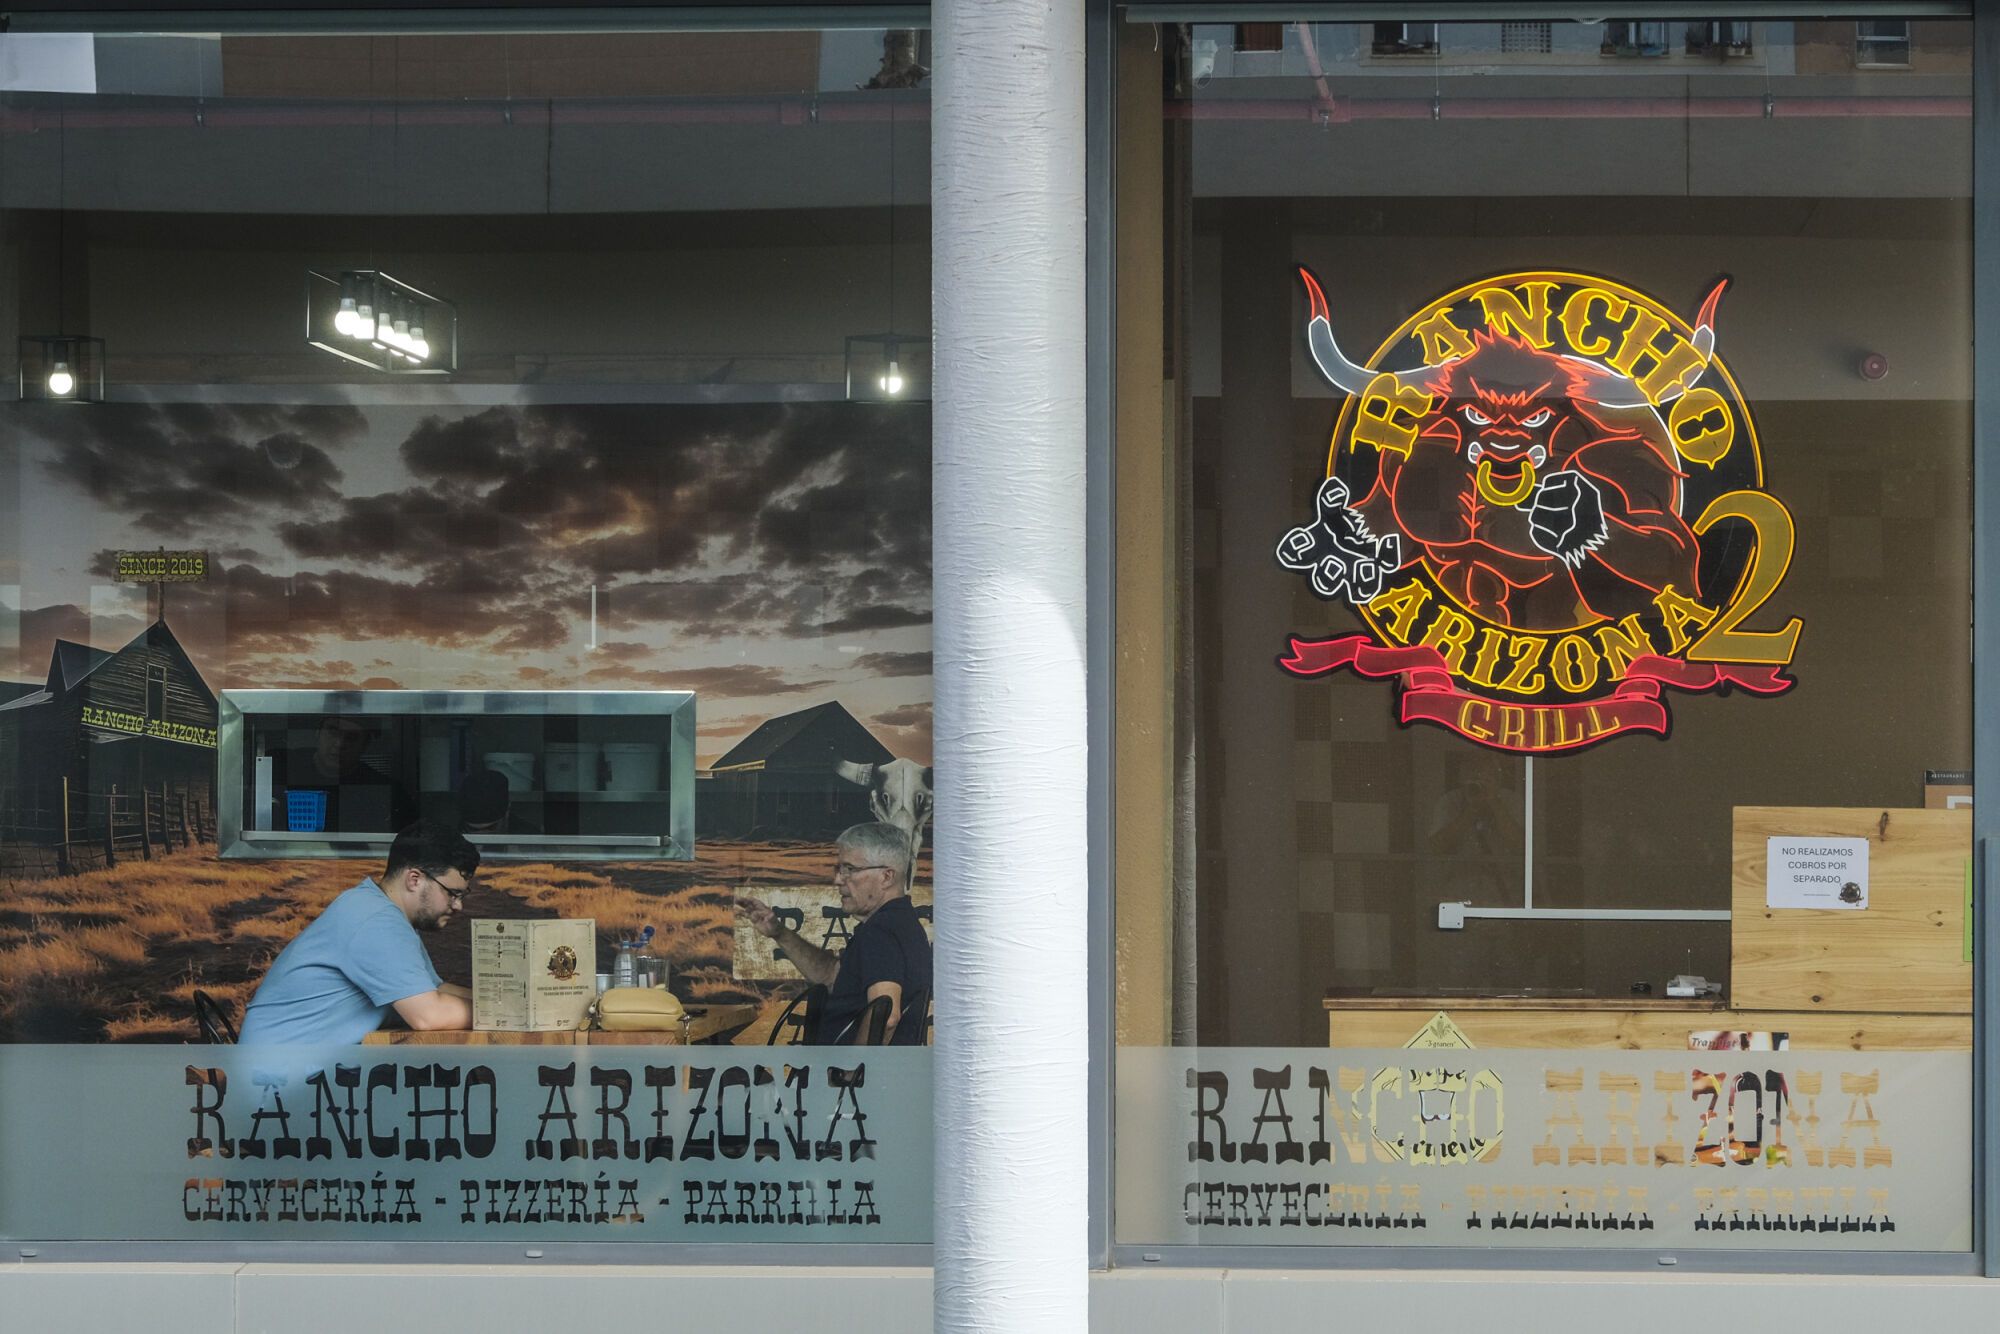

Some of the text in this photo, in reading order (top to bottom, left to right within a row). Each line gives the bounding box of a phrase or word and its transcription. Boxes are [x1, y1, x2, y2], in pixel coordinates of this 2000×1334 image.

[1349, 280, 1736, 470] RANCHO
[119, 557, 203, 575] SINCE 2019
[1686, 489, 1804, 665] 2
[1369, 577, 1720, 695] ARIZONA
[81, 706, 218, 747] RANCHO ARIZONA
[1456, 697, 1623, 751] GRILL
[1782, 847, 1853, 857] NO REALIZAMOS
[1788, 861, 1847, 870] COBROS POR
[1793, 874, 1841, 884] SEPARADO
[185, 1062, 877, 1163] RANCHO ARIZONA
[1186, 1064, 1893, 1169] RANCHO ARIZONA
[182, 1170, 421, 1224] CERVECERÍA
[460, 1171, 645, 1225] PIZZERÍA
[683, 1179, 881, 1225] PARRILLA
